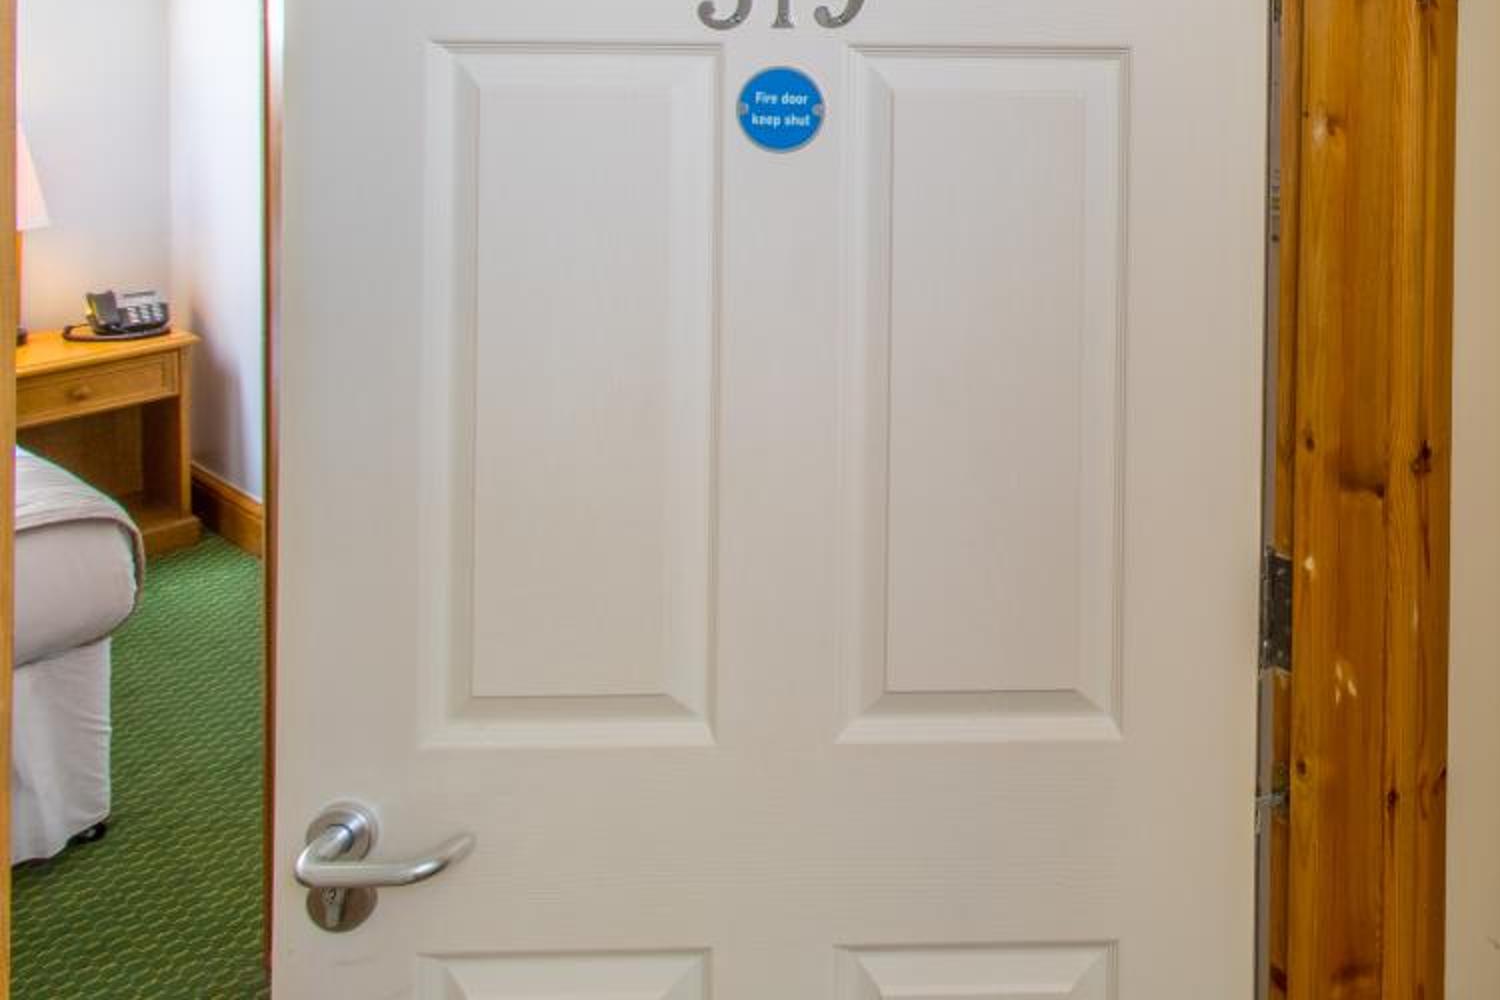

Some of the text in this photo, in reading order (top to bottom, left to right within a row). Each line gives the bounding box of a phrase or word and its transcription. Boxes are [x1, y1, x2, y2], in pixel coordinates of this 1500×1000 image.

[755, 91, 808, 105] Fire door
[751, 112, 811, 129] keep shut
